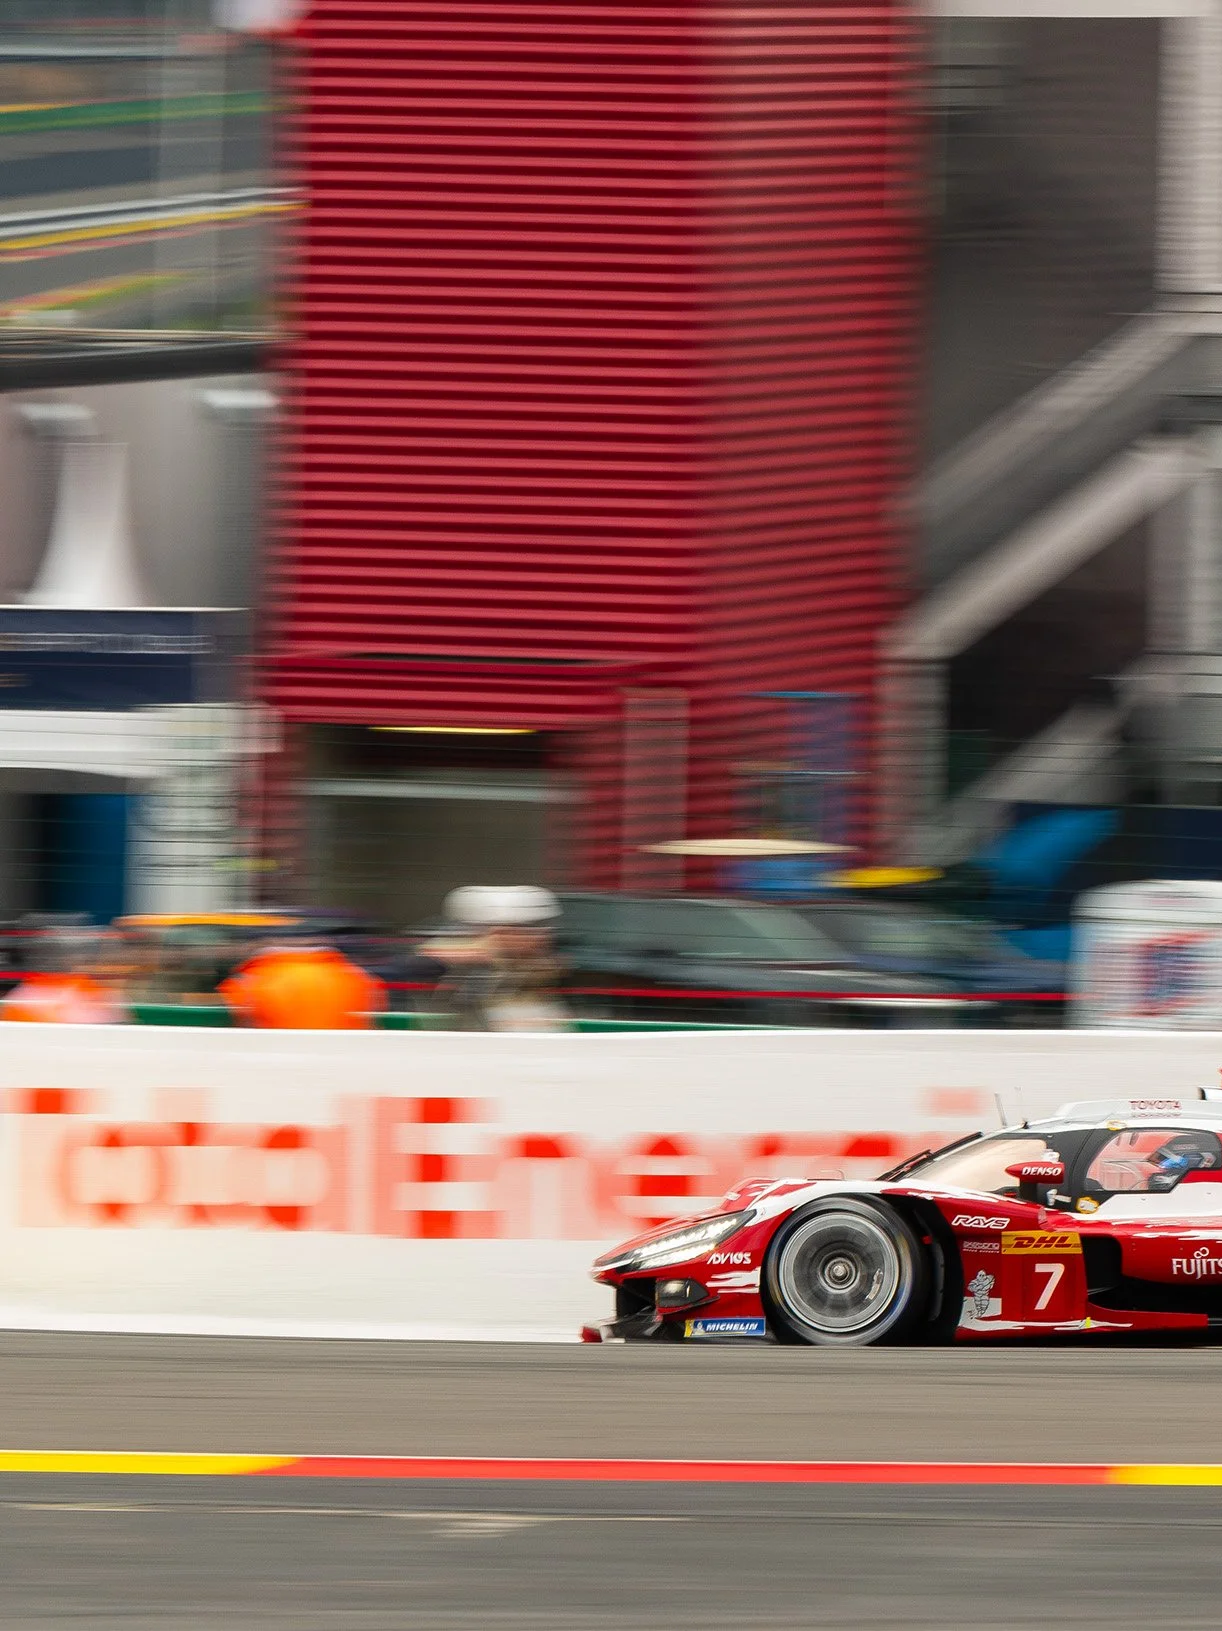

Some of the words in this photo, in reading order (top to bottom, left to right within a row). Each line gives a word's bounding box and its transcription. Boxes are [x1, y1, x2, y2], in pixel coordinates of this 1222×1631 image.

[1128, 1100, 1182, 1110] TOYOTA
[1021, 1166, 1062, 1176] DENSO
[951, 1214, 1011, 1229] RAYS
[1012, 1236, 1073, 1248] DHL
[1034, 1263, 1065, 1310] 7
[705, 1321, 759, 1331] MICHELIN
